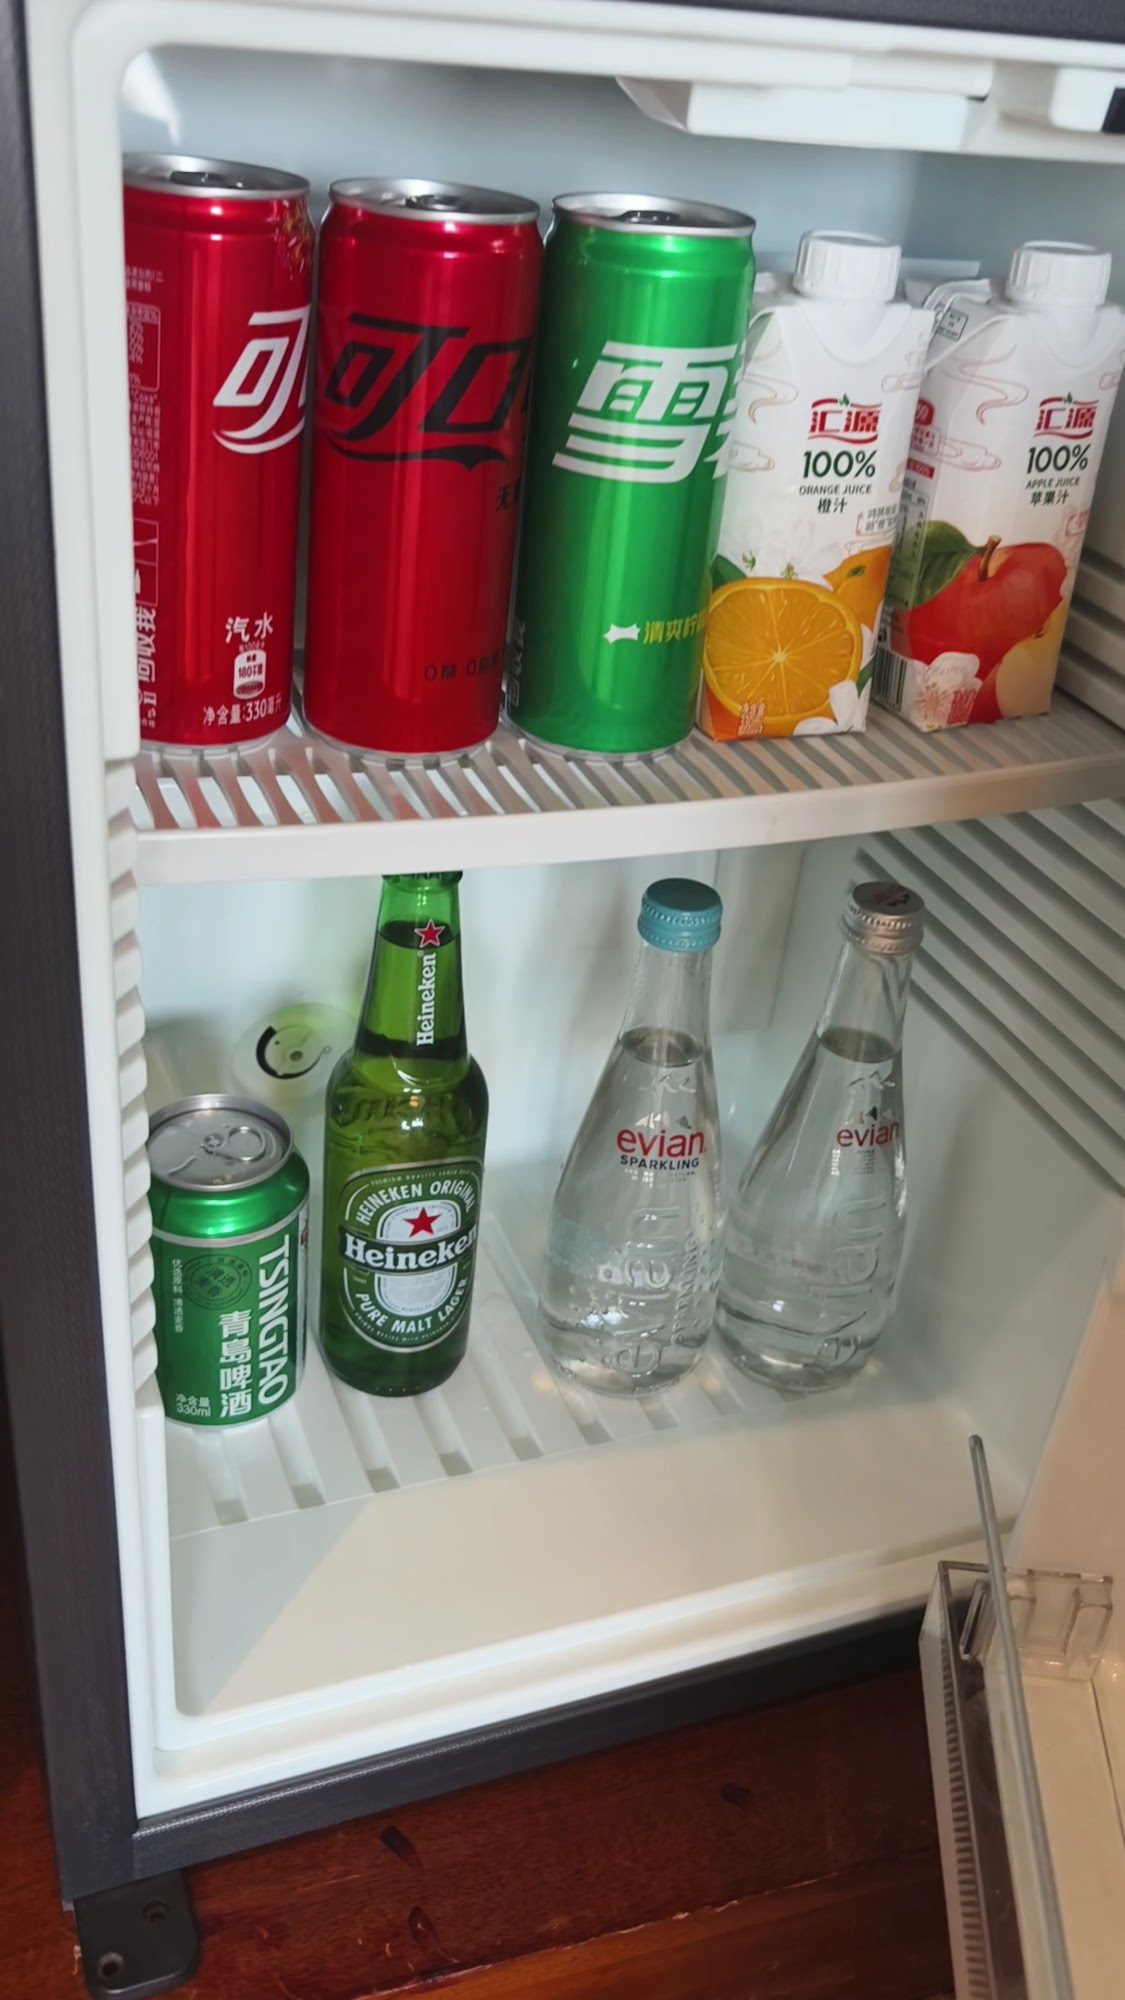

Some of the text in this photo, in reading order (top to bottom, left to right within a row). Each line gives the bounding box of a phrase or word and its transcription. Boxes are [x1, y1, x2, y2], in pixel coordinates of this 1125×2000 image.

[212, 304, 310, 440] 可
[324, 313, 534, 442] 可口
[808, 408, 882, 434] 汇源
[1035, 405, 1098, 433] 汇源
[803, 449, 878, 479] 100%
[1027, 444, 1091, 474] 100%
[799, 484, 872, 496] ORANGE JUICE
[1025, 476, 1080, 489] APPLE JUICE
[817, 498, 848, 514] 橙汁
[1030, 490, 1069, 506] 苹果汁
[225, 611, 274, 644] 汽水
[417, 953, 437, 1046] Heineken
[616, 1128, 705, 1158] evian
[836, 1121, 900, 1148] evian
[620, 1155, 699, 1170] SPARKLING
[356, 1182, 423, 1226] HEINEKEN
[430, 1179, 476, 1214] ORIGINAL
[344, 1223, 477, 1270] Heineken
[258, 1234, 290, 1405] TSINGTAO
[356, 1293, 388, 1327] PURE
[391, 1318, 432, 1334] MALT
[439, 1278, 468, 1322] LAGER
[176, 1393, 211, 1408] 净含量
[176, 1403, 211, 1417] 330ml
